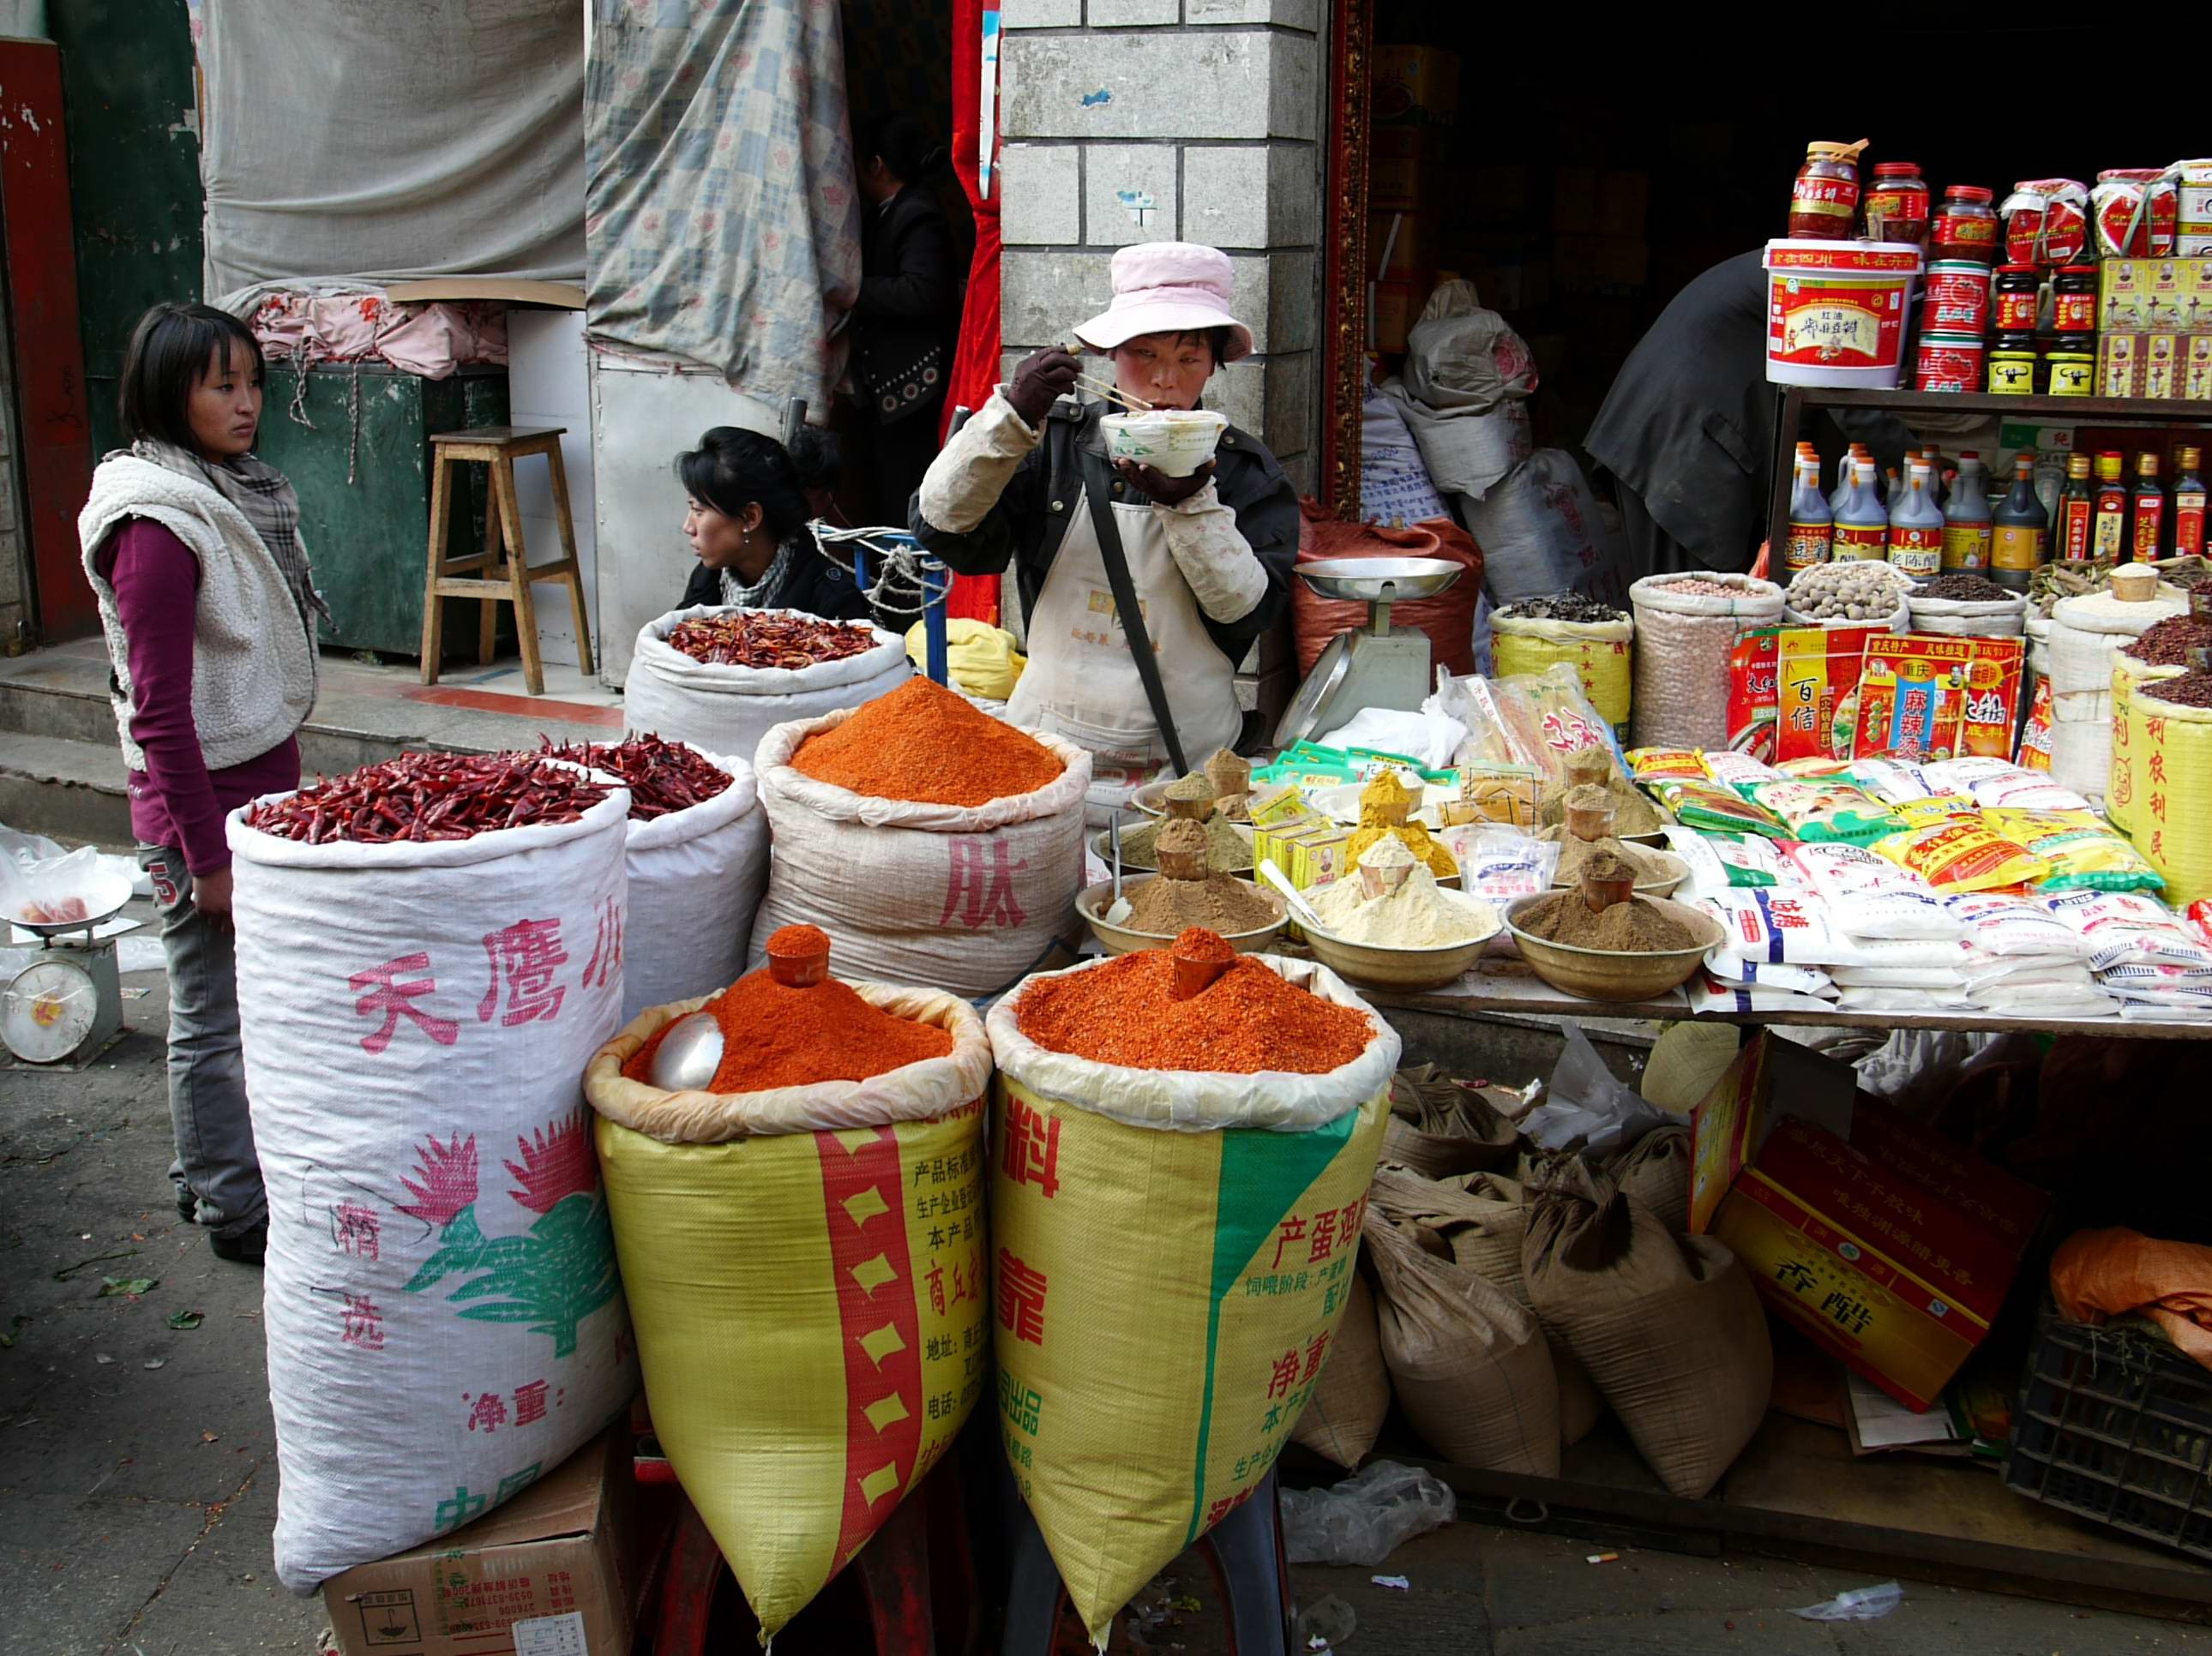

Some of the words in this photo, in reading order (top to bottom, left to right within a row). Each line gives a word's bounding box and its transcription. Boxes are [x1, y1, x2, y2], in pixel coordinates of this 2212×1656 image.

[1902, 663, 1930, 678] 重庆
[1789, 677, 1818, 732] 百信
[1896, 688, 1928, 760] 麻辣烫
[2145, 716, 2168, 867] 利农利民
[147, 861, 178, 905] 5
[1774, 1255, 1874, 1335] 香醋
